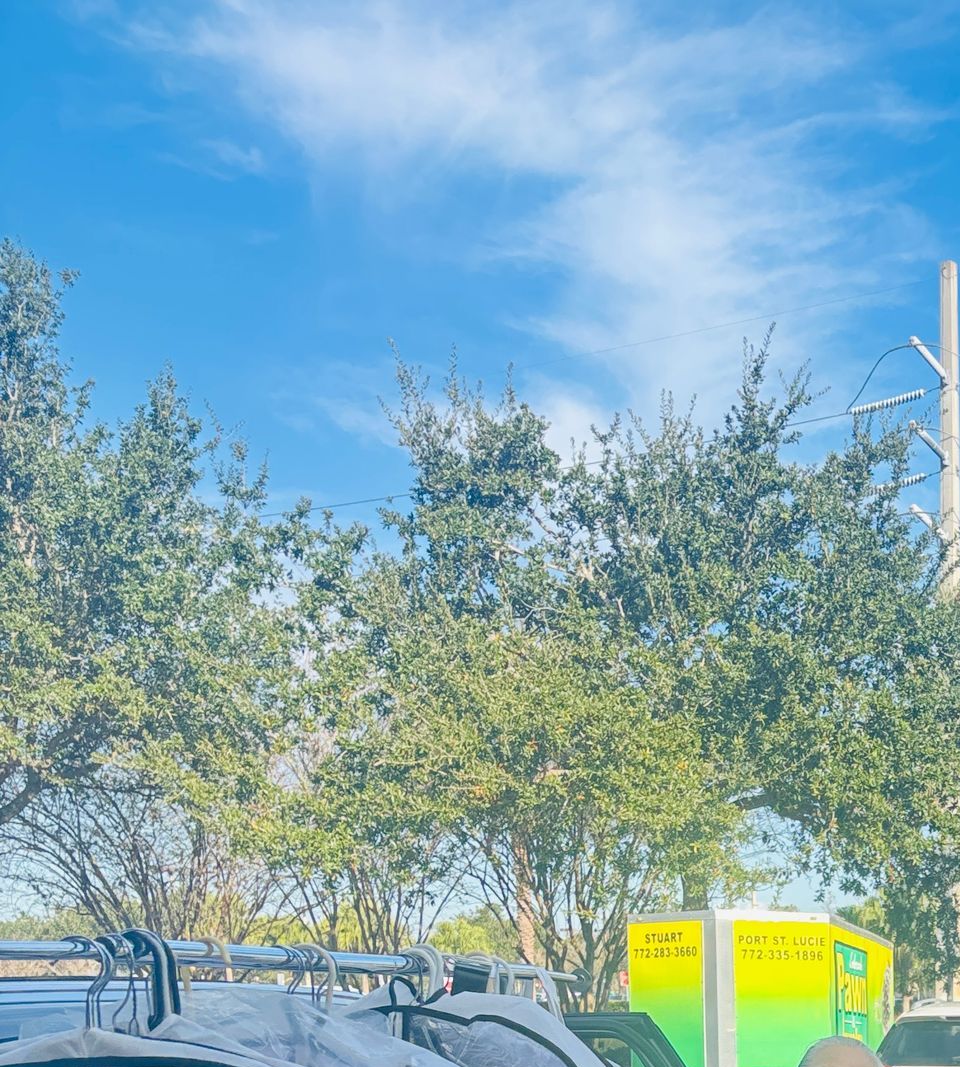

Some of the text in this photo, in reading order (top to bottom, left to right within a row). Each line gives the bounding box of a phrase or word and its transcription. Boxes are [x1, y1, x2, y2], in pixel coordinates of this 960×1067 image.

[644, 932, 683, 944] STUART
[738, 935, 826, 947] PORT ST. LUCIE
[633, 945, 698, 959] 772-283-3660
[741, 949, 824, 961] 772-335-1896
[836, 952, 867, 1015] Pawn
